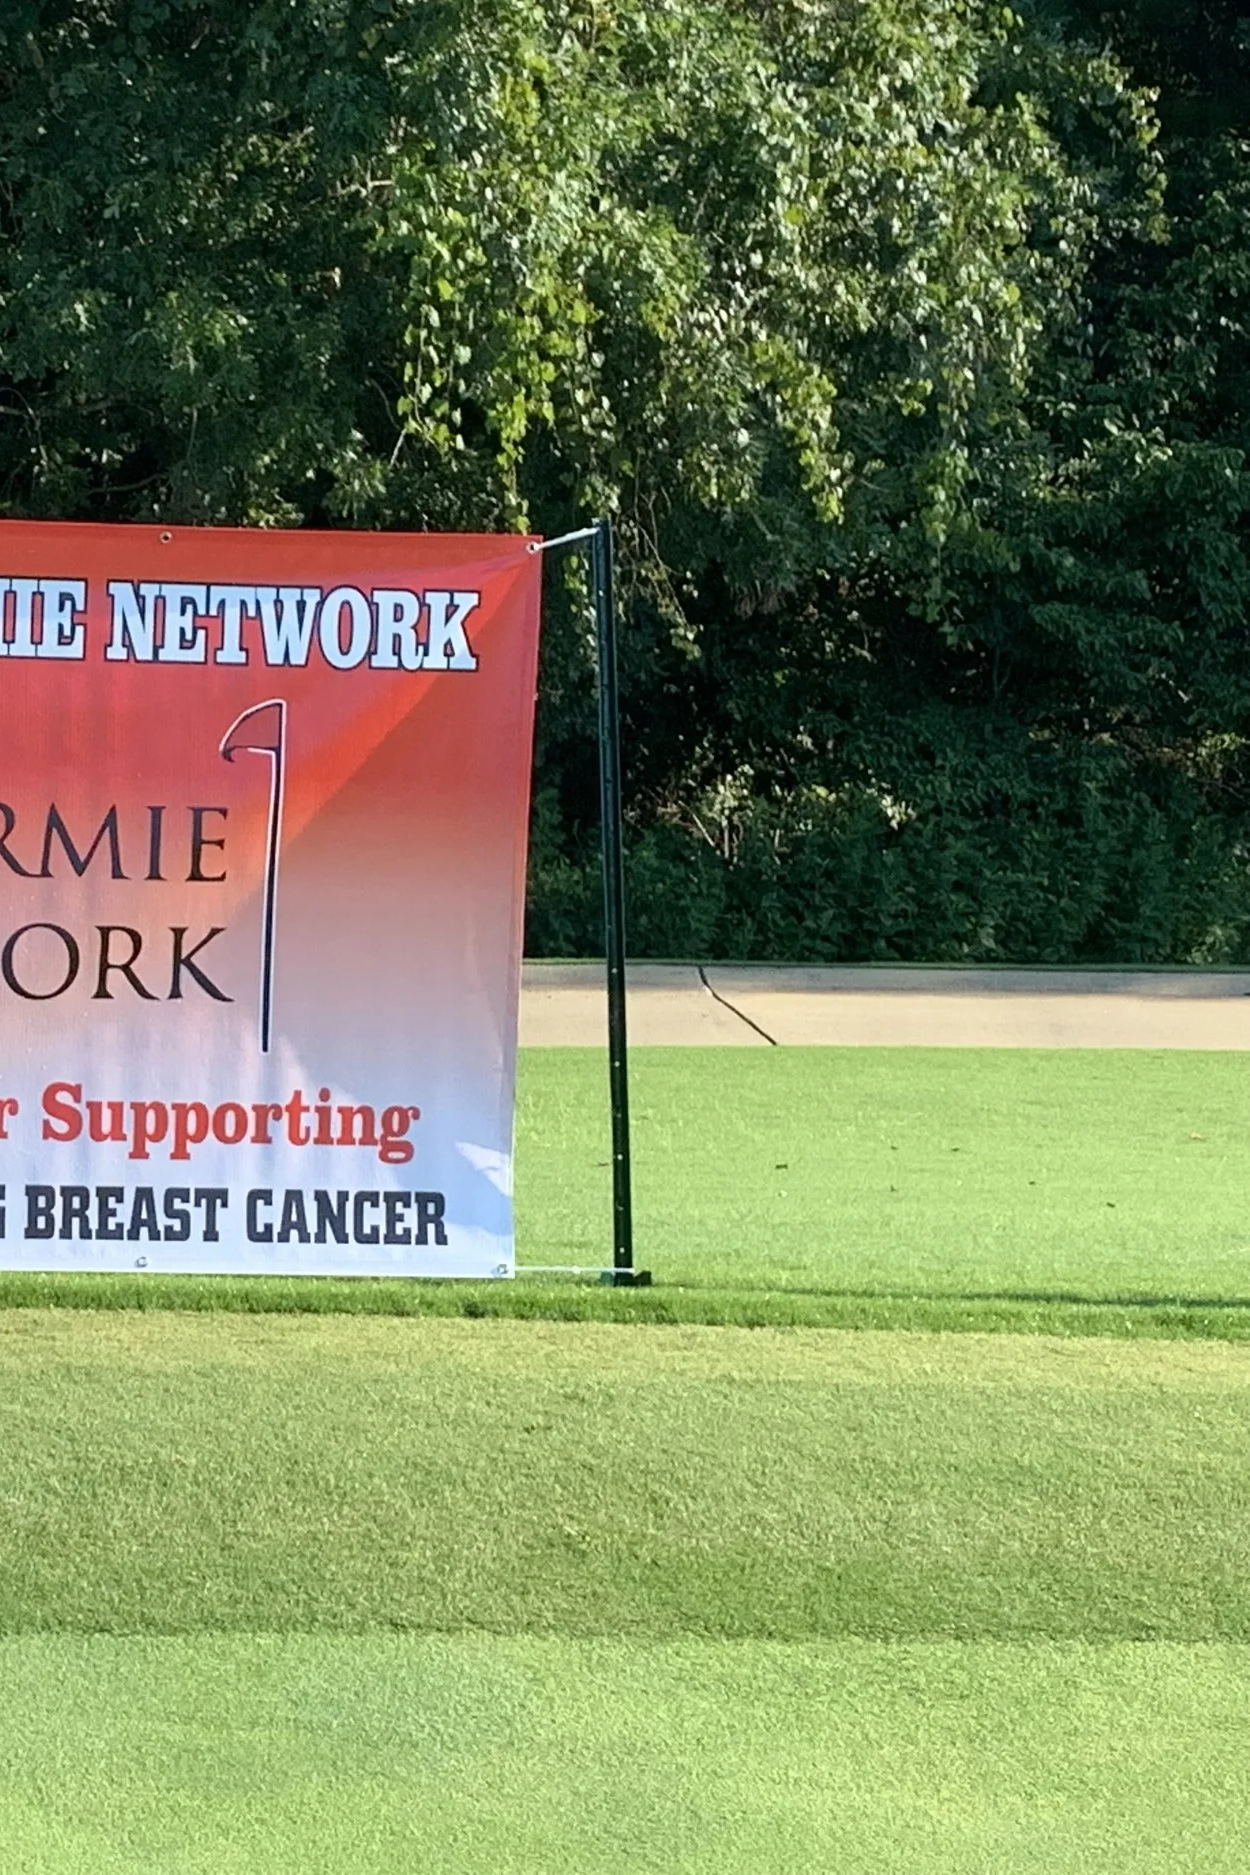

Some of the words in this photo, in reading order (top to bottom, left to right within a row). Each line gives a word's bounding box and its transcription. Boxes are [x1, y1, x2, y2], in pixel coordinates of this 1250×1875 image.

[105, 579, 480, 672] NETWORK
[42, 1082, 421, 1164] Supporting
[23, 1184, 228, 1243] BREAST
[246, 1189, 449, 1246] CANCER
